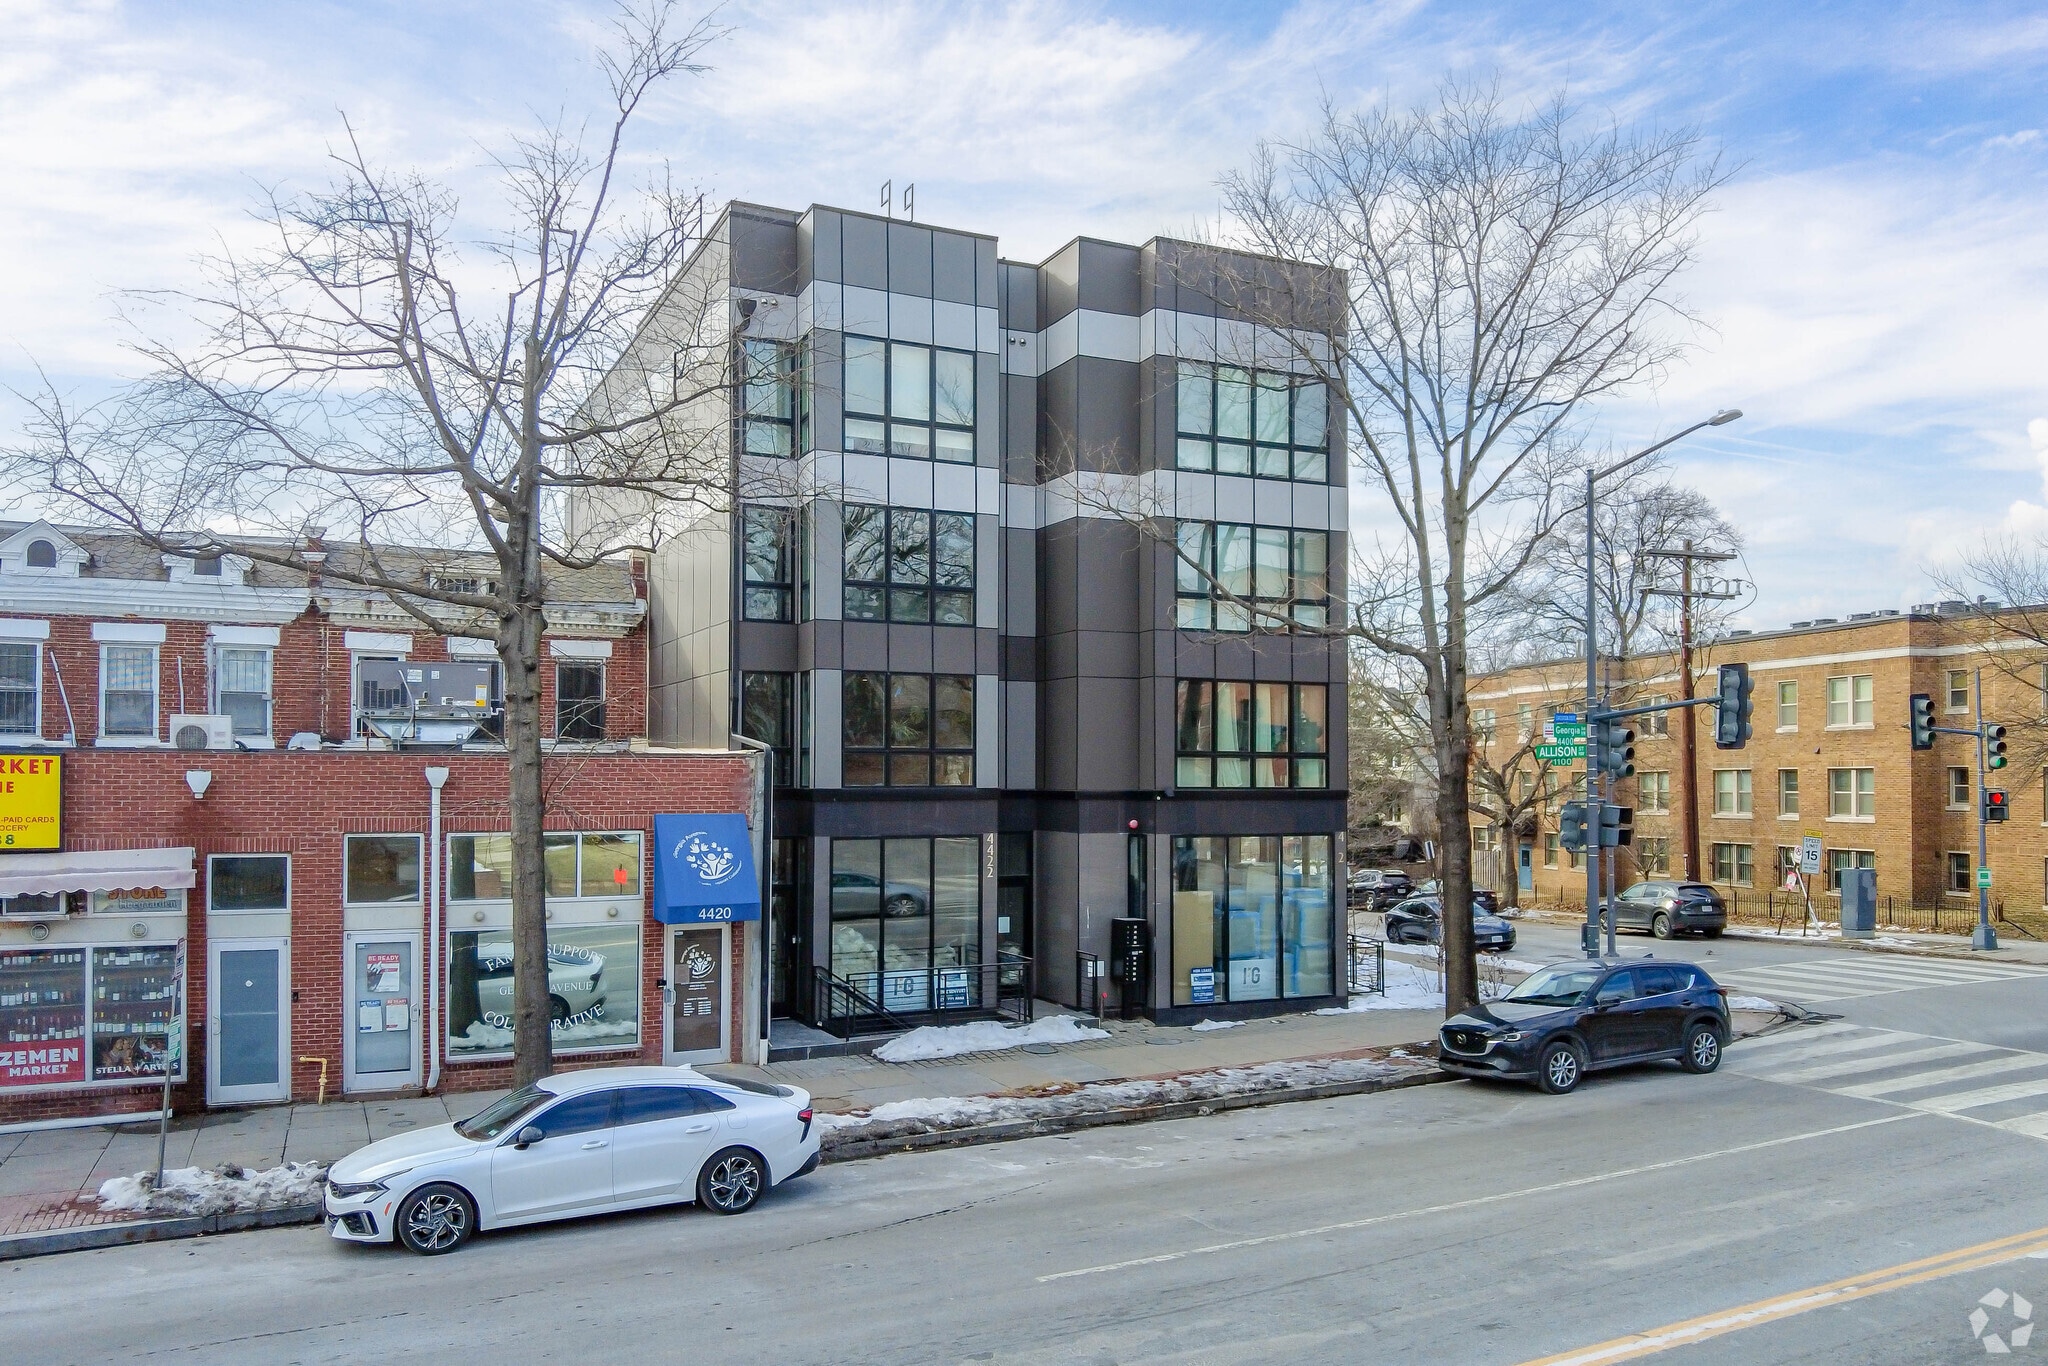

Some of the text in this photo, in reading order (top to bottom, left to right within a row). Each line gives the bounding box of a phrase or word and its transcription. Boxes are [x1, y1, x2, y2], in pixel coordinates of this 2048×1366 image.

[1555, 726, 1581, 737] Georgia
[1539, 746, 1578, 757] ALLISON
[1553, 758, 1572, 766] 1100
[0, 781, 14, 793] E
[986, 832, 994, 878] 4422
[1806, 850, 1818, 861] 15
[698, 907, 732, 919] 4420
[546, 942, 607, 964] SUPPORT
[549, 981, 594, 993] AVENUE
[0, 1047, 79, 1066] ZEMEN
[9, 1063, 69, 1077] MARKET
[95, 1062, 179, 1075] STELLA ARTOS
